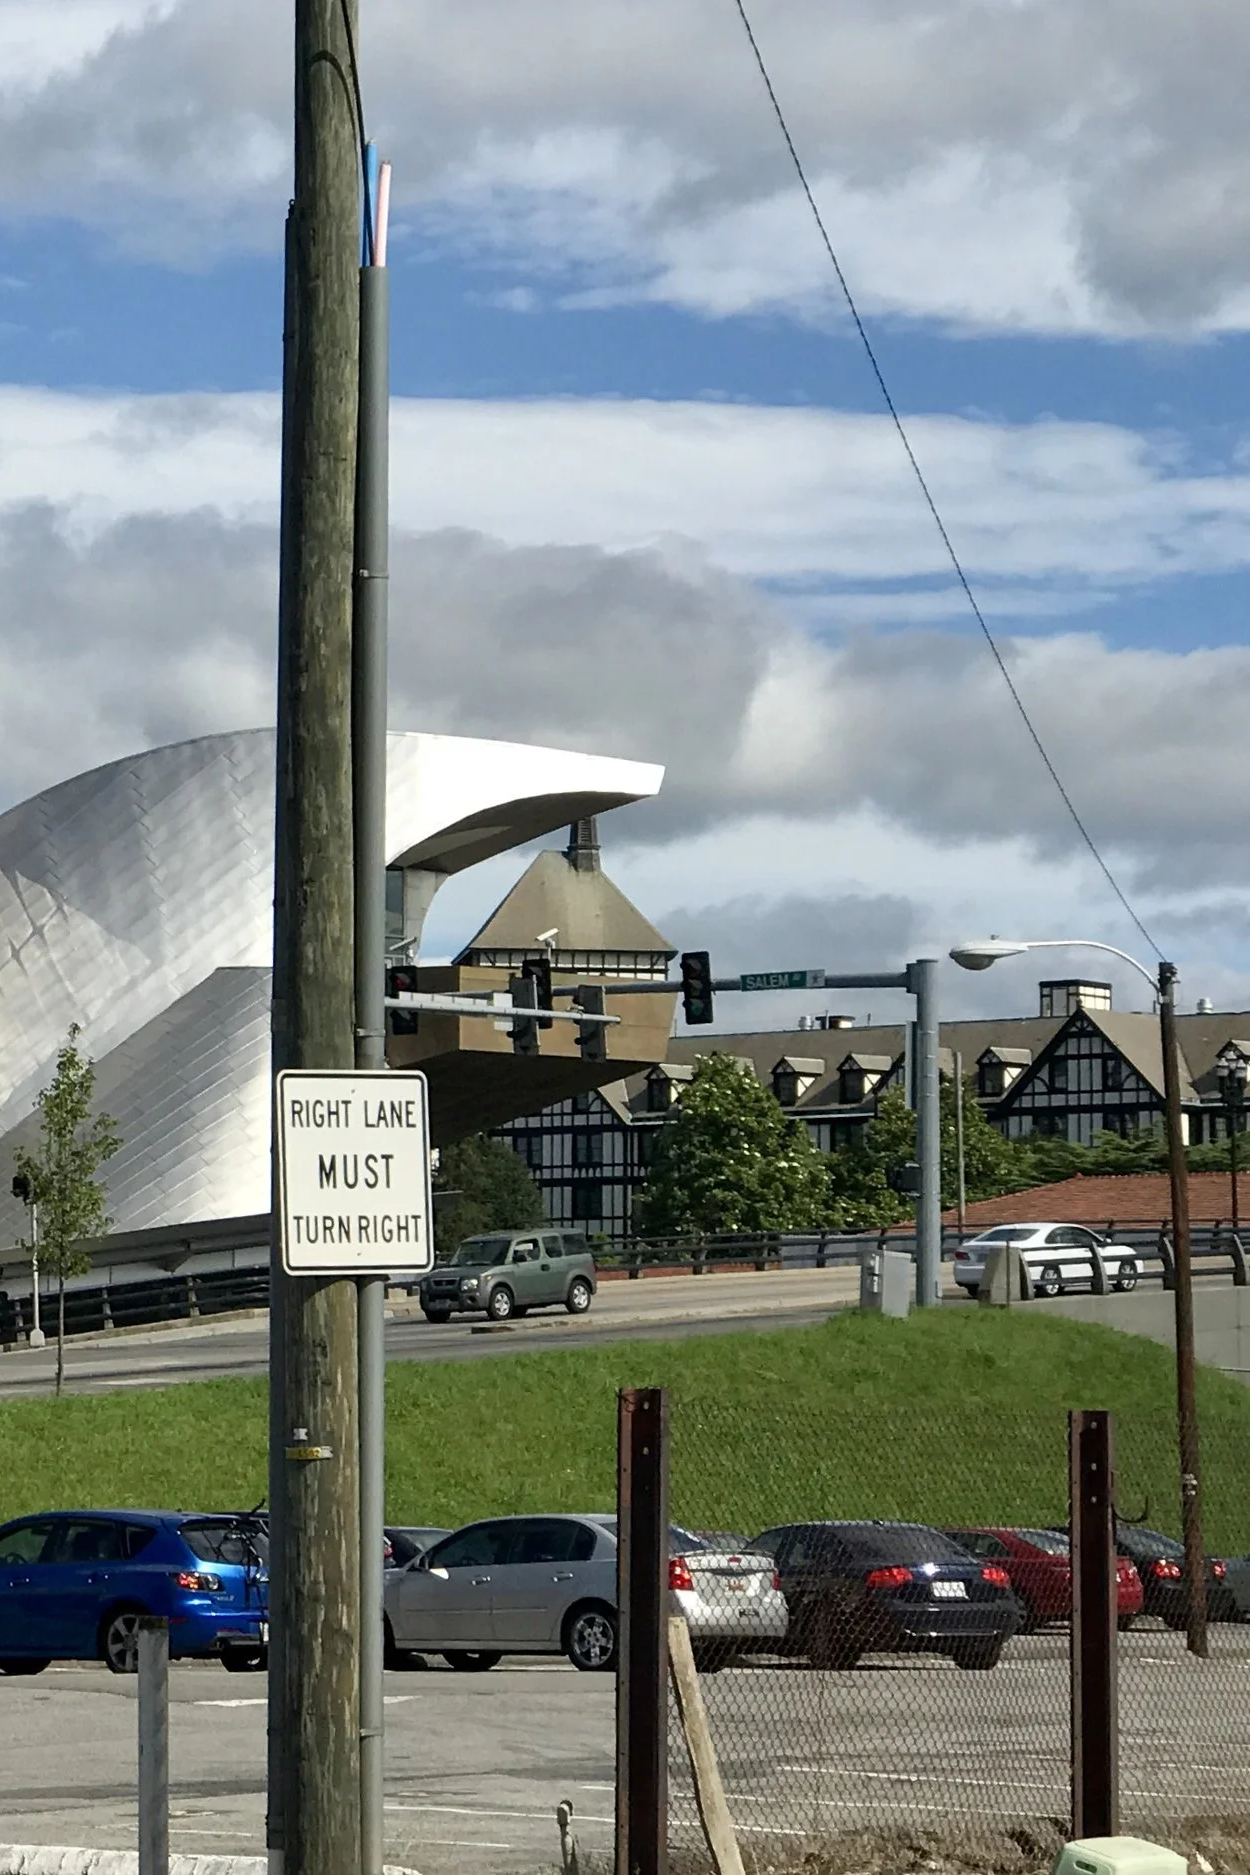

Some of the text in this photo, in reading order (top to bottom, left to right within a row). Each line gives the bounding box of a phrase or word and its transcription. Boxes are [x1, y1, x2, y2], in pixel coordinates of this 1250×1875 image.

[746, 973, 790, 989] SALEM
[291, 1099, 417, 1128] RIGHT LANE
[318, 1154, 394, 1189] MUST
[293, 1215, 422, 1244] TURN RIGHT
